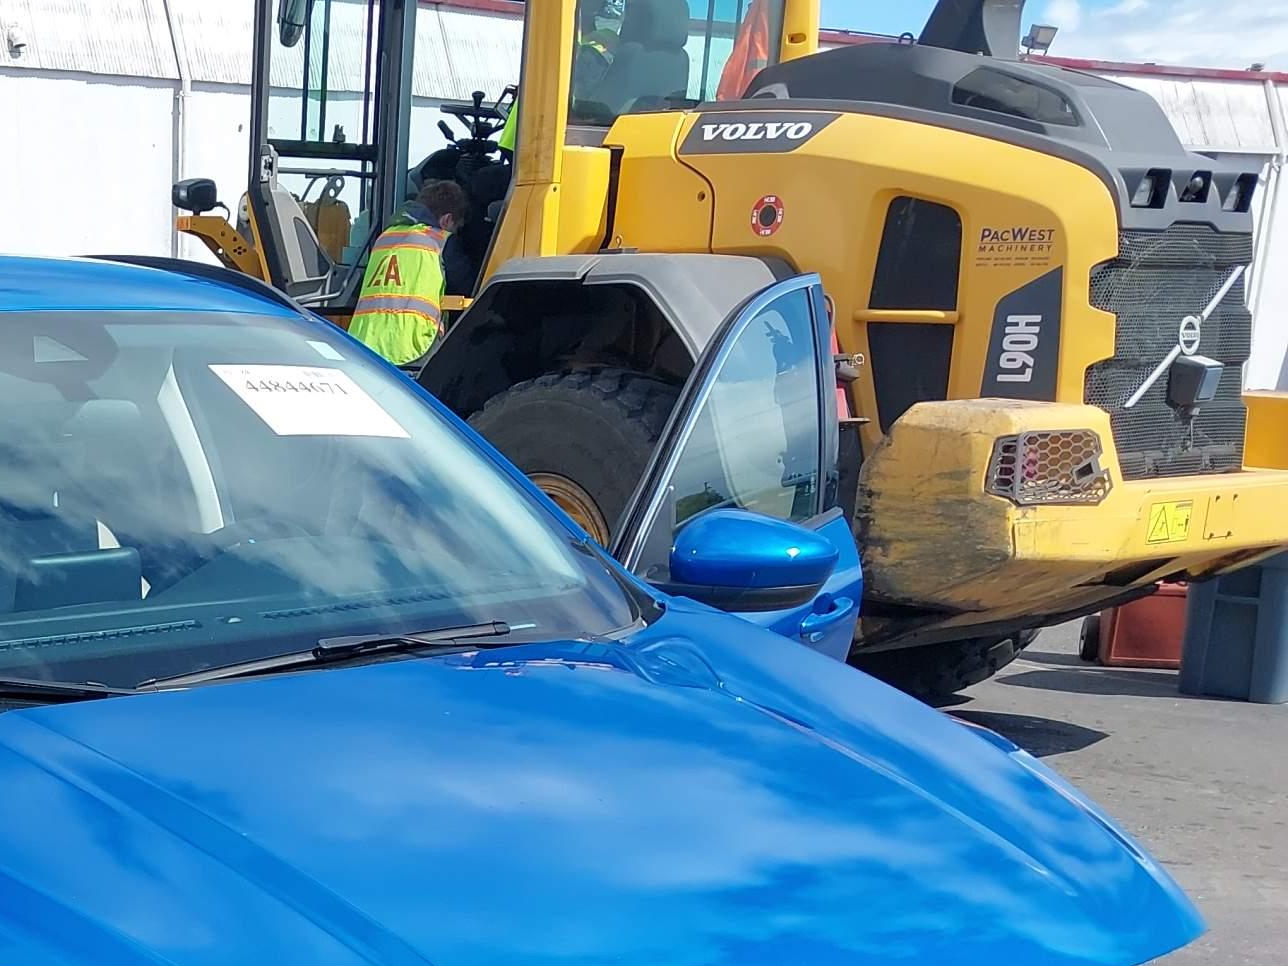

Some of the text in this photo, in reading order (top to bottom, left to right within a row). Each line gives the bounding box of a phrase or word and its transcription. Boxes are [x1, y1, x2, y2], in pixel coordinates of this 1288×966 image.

[701, 122, 812, 141] VOLVO
[978, 244, 1053, 252] MACHINERY
[997, 315, 1042, 382] L90H
